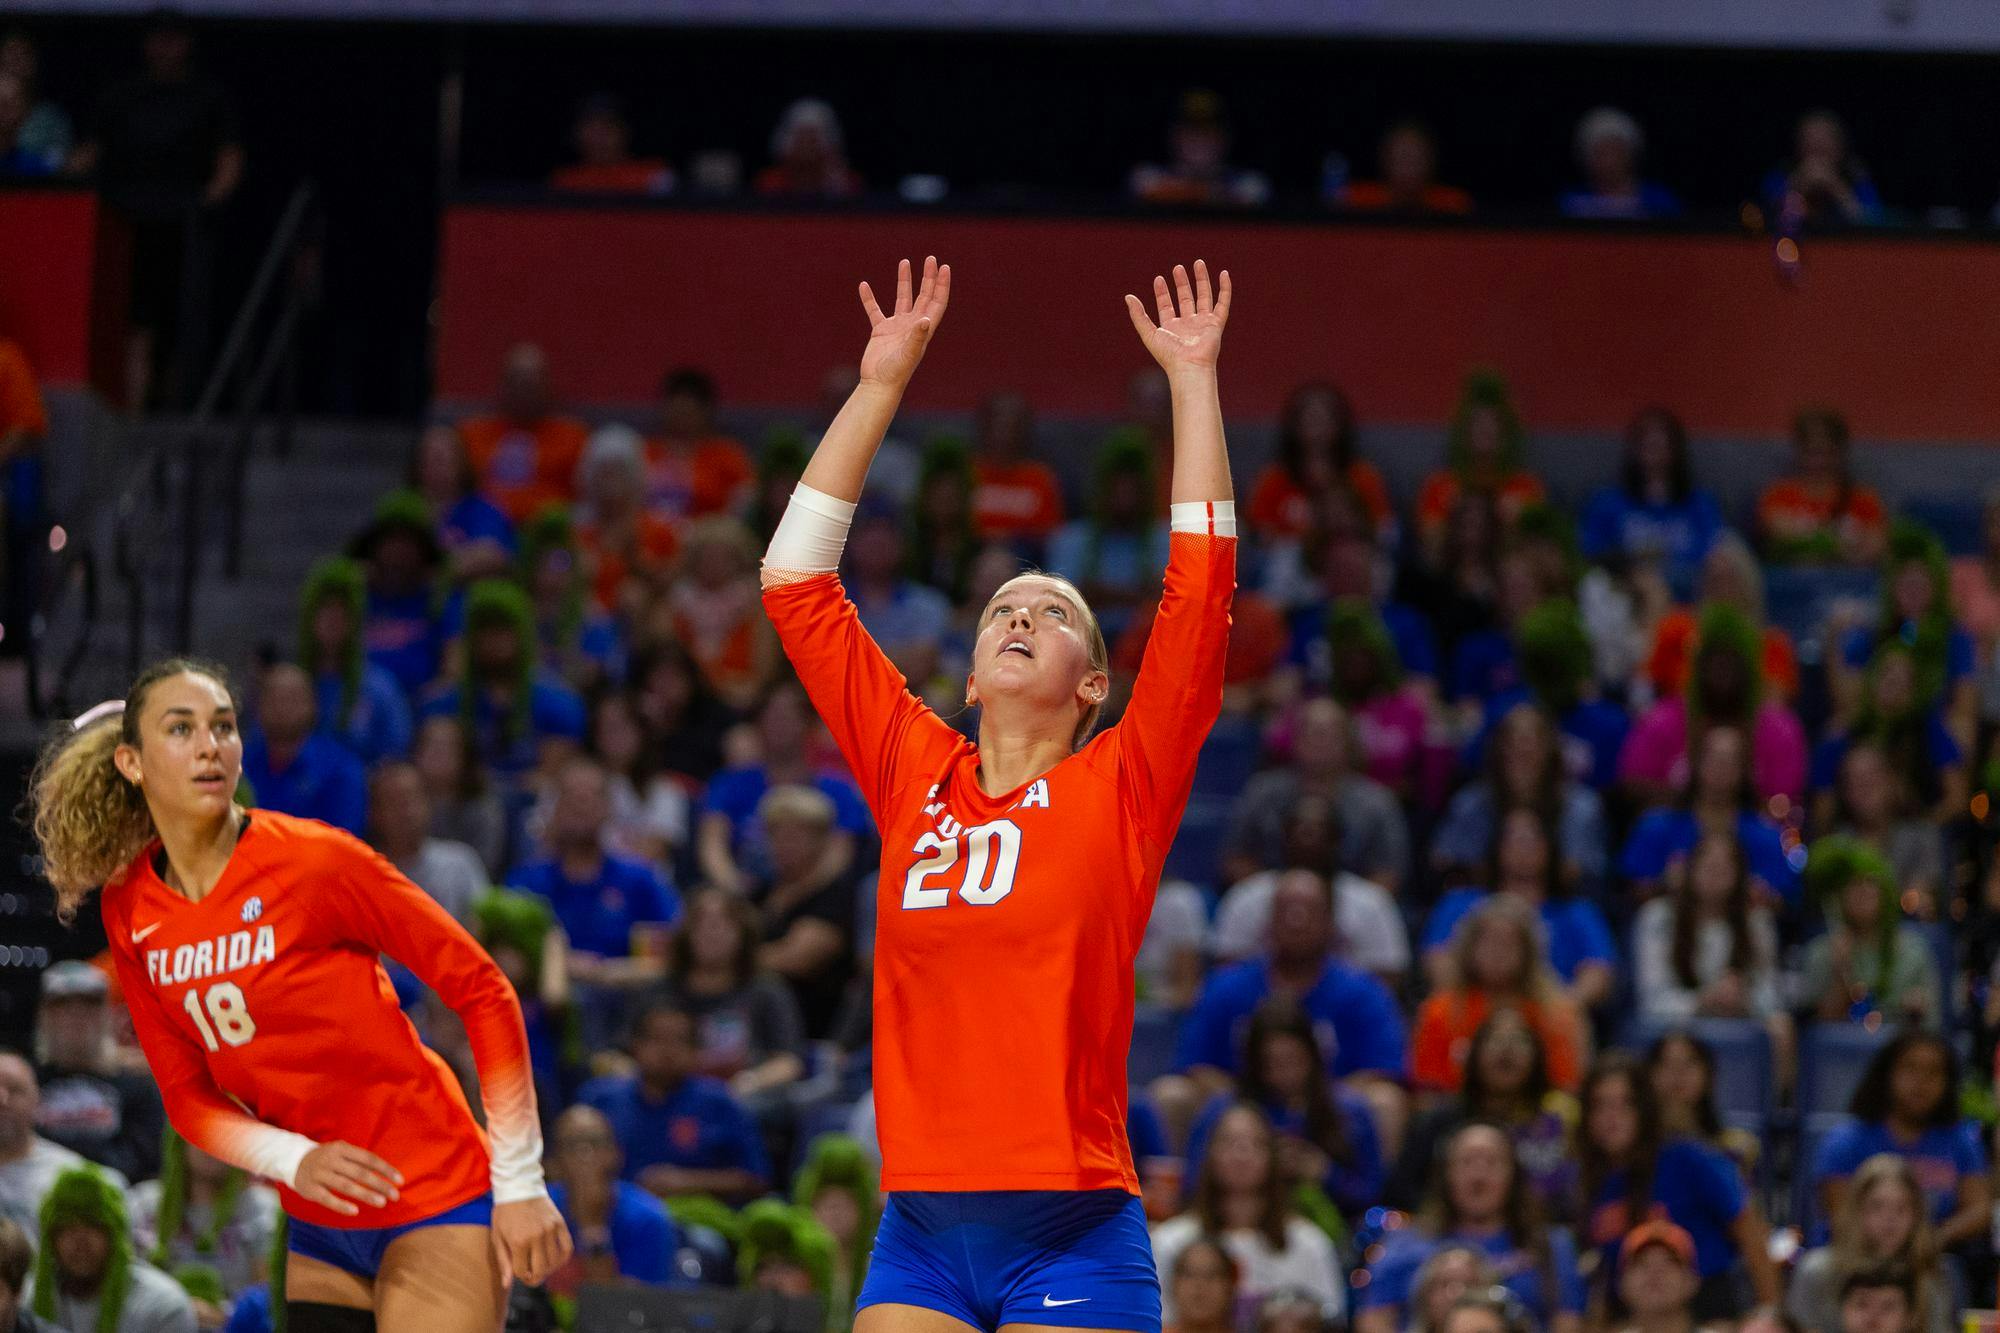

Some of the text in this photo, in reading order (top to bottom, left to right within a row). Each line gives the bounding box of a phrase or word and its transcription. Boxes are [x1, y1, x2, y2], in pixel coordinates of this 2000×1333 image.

[901, 818, 1022, 910] 20
[147, 924, 276, 986] FLORIDA
[183, 981, 257, 1052] 18
